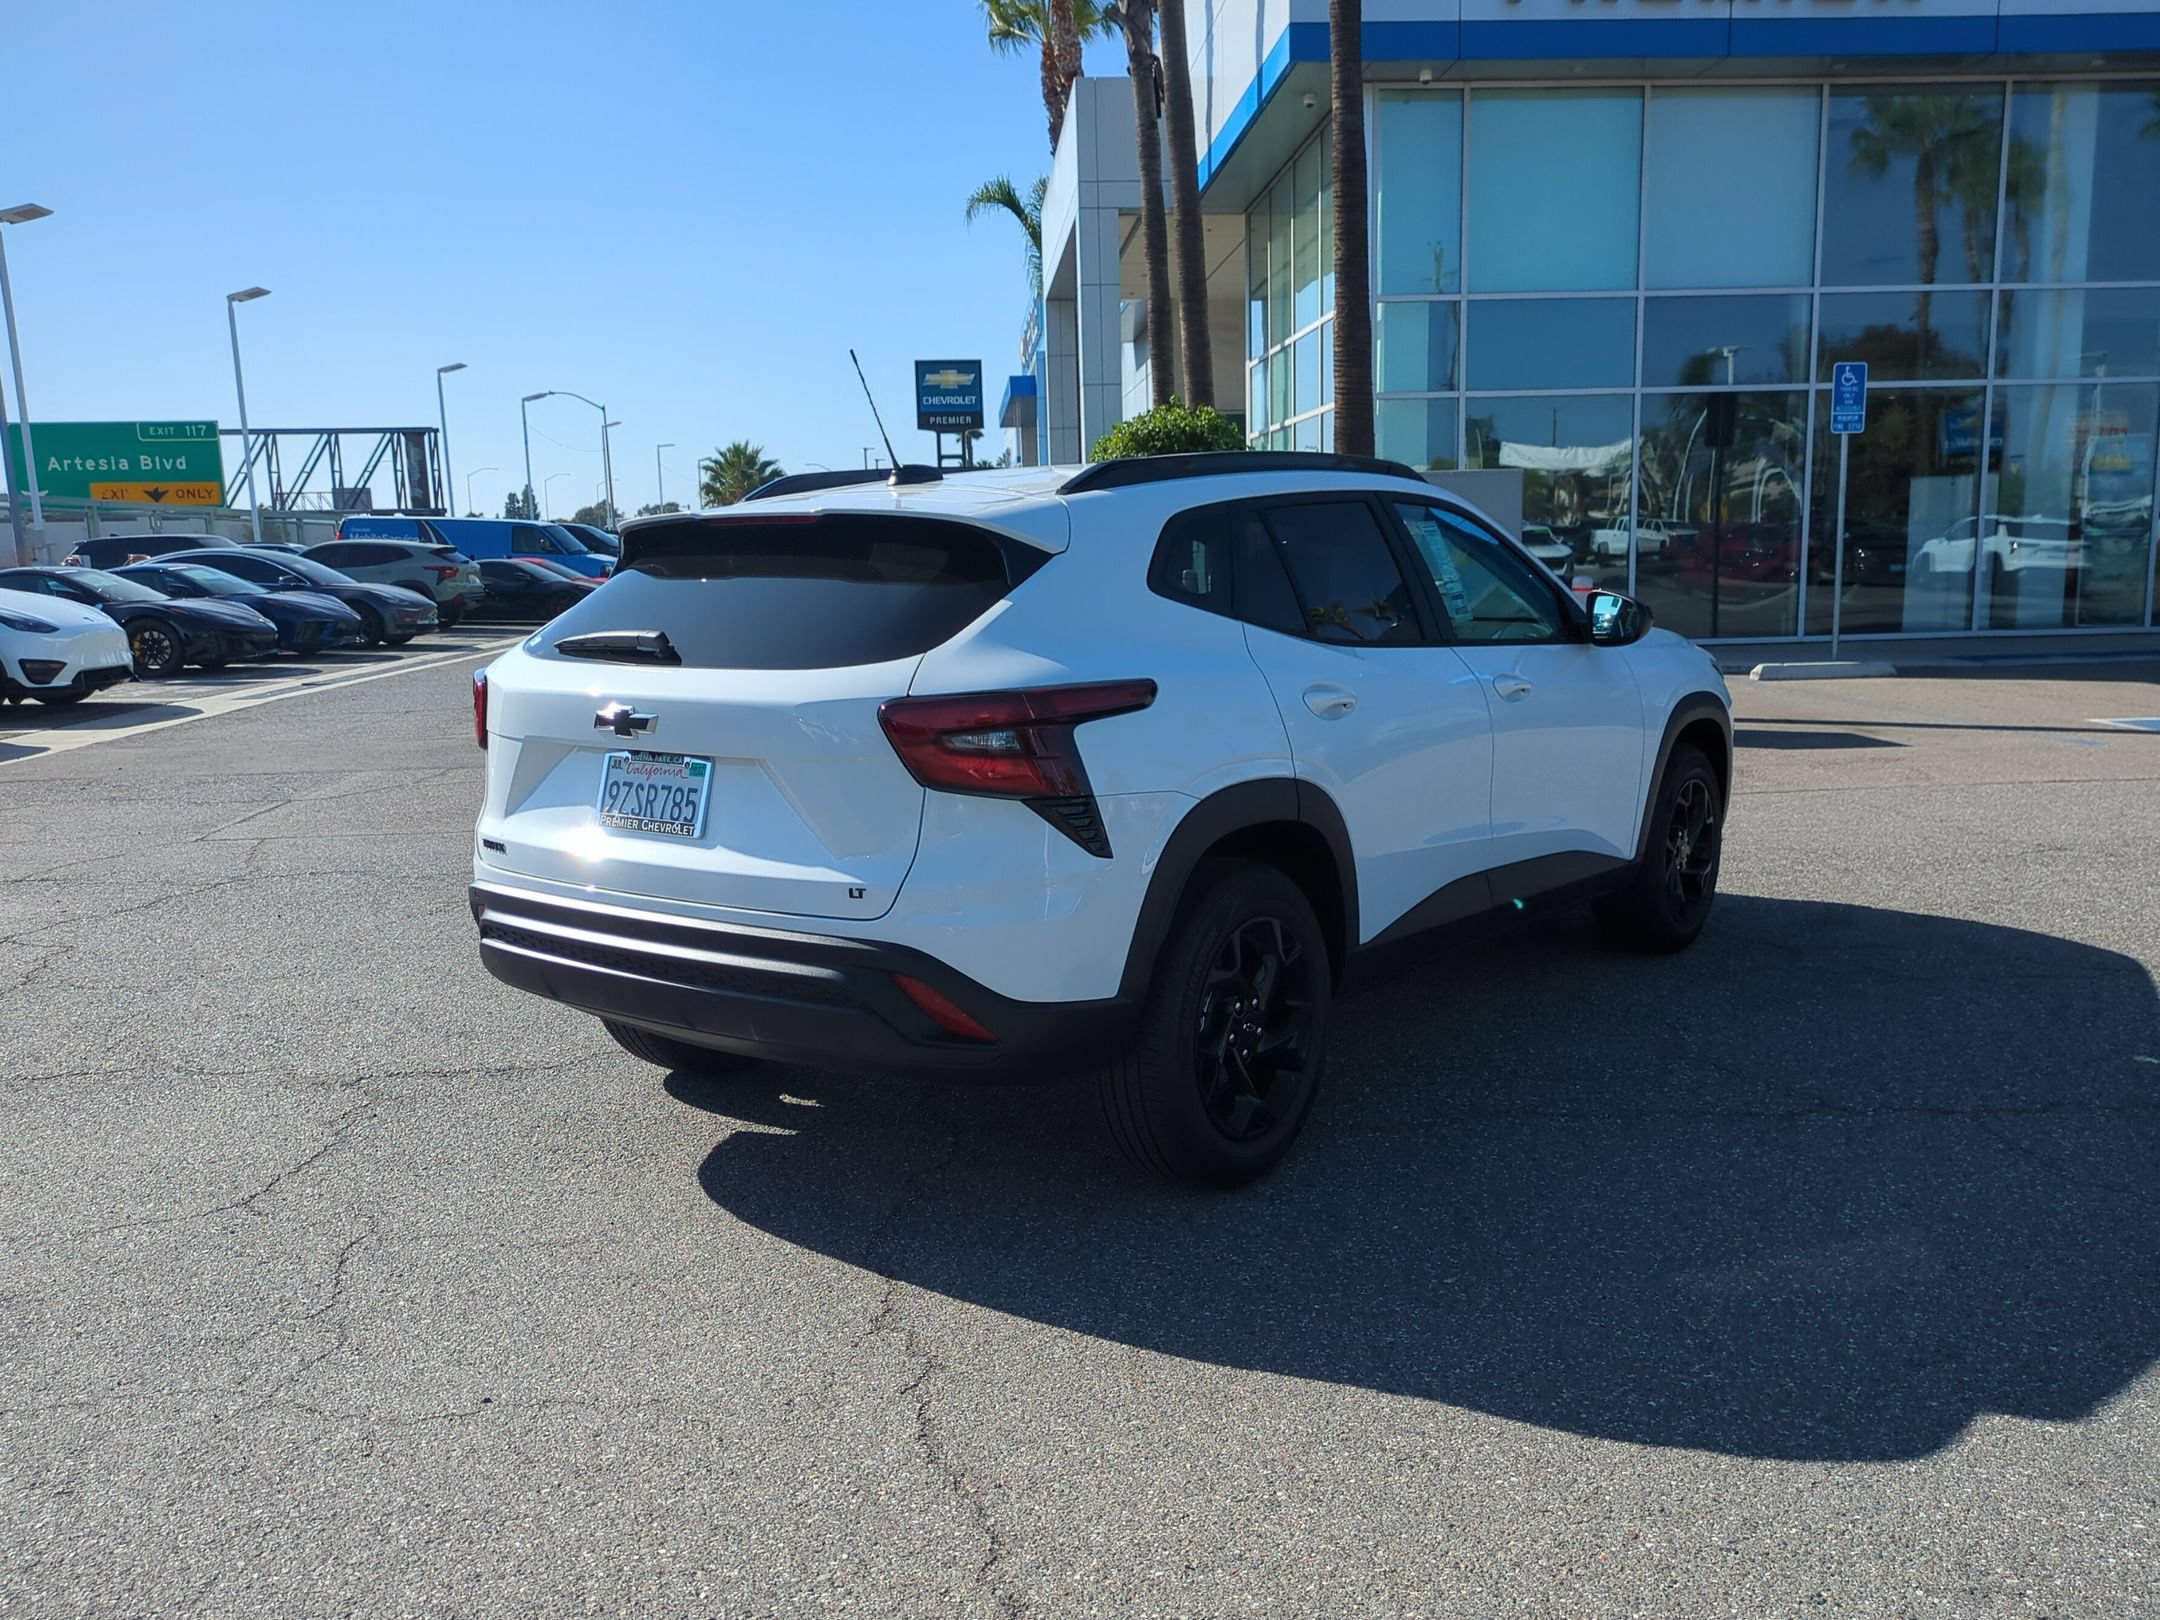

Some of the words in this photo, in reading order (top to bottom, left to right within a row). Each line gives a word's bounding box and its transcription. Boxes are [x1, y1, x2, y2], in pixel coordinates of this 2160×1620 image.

[922, 395, 977, 405] CHEVROLET
[929, 415, 972, 425] PREMIER
[149, 426, 175, 436] EXIT
[185, 425, 207, 437] 117
[48, 456, 129, 472] Artesia
[140, 455, 187, 471] Blvd
[175, 488, 214, 499] ONLY
[625, 762, 689, 781] California
[605, 780, 698, 823] 9ZSR785
[600, 815, 639, 830] PREMIER
[641, 819, 695, 836] CHEVROLET
[849, 887, 867, 899] LT
